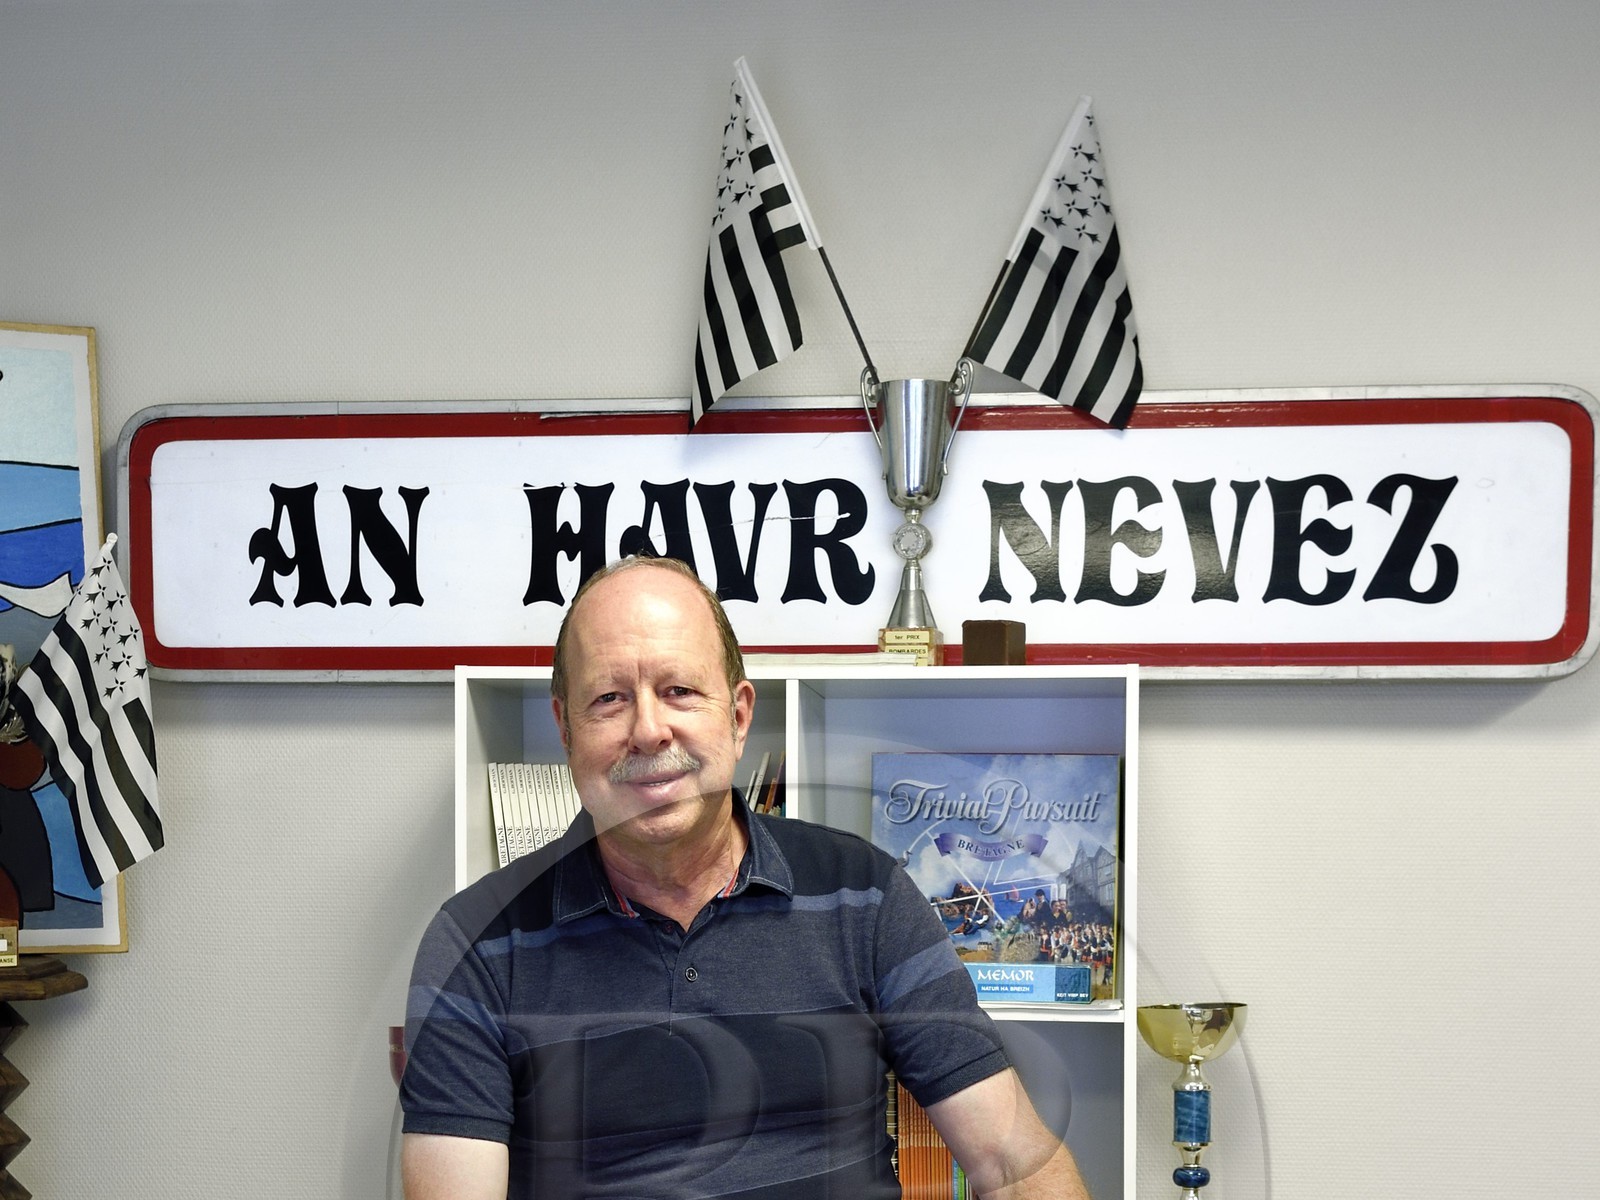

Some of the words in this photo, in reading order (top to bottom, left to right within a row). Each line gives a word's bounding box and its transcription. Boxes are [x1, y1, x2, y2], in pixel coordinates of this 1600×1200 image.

[248, 481, 430, 607] AN
[522, 477, 876, 607] HAVR
[978, 473, 1459, 606] NEVEZ
[884, 779, 990, 824] Trivial
[978, 778, 1107, 834] Pursuit
[497, 826, 507, 864] BRETAGNE
[957, 838, 1026, 858] BRETAGNE
[978, 969, 1034, 981] MEMOR
